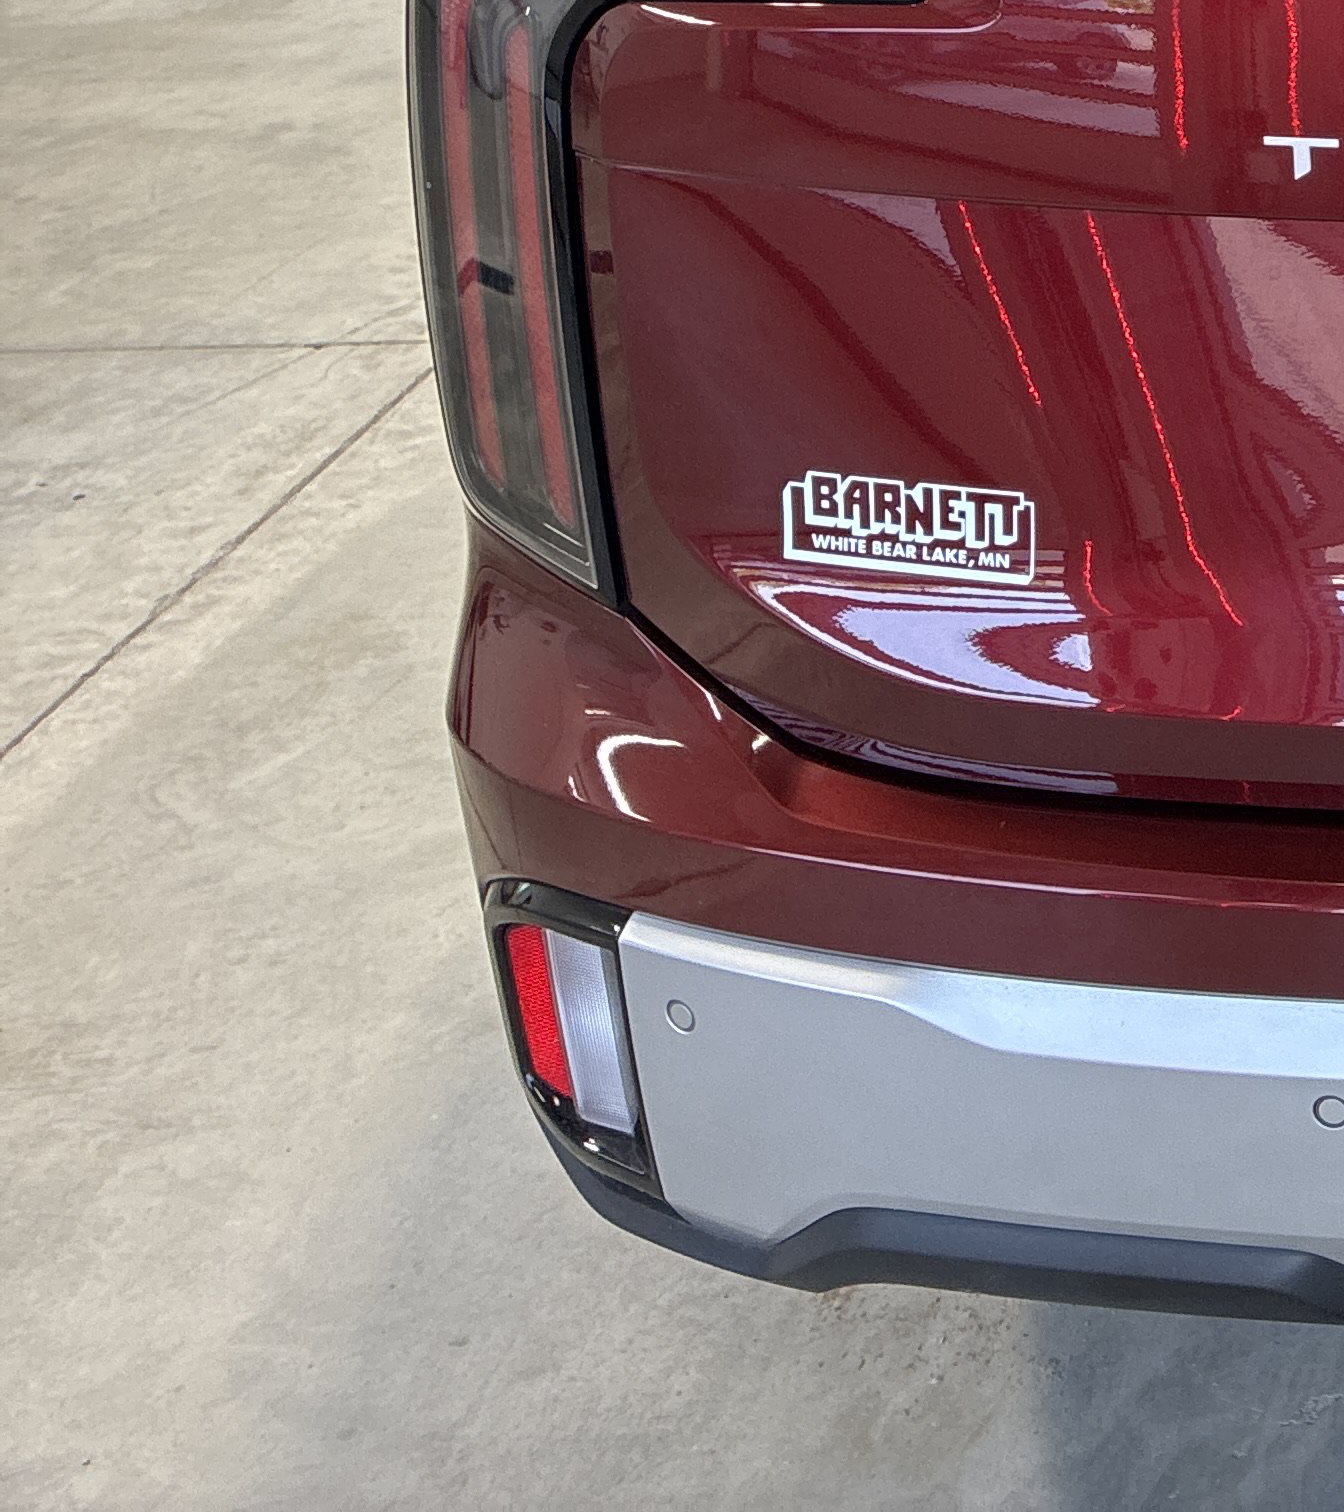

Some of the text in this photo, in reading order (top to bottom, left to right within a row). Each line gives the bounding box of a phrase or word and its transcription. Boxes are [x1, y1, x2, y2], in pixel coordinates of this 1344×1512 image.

[806, 471, 1024, 547] BARNETT
[811, 533, 1010, 569] WHITE BEAR LAKE, MN
